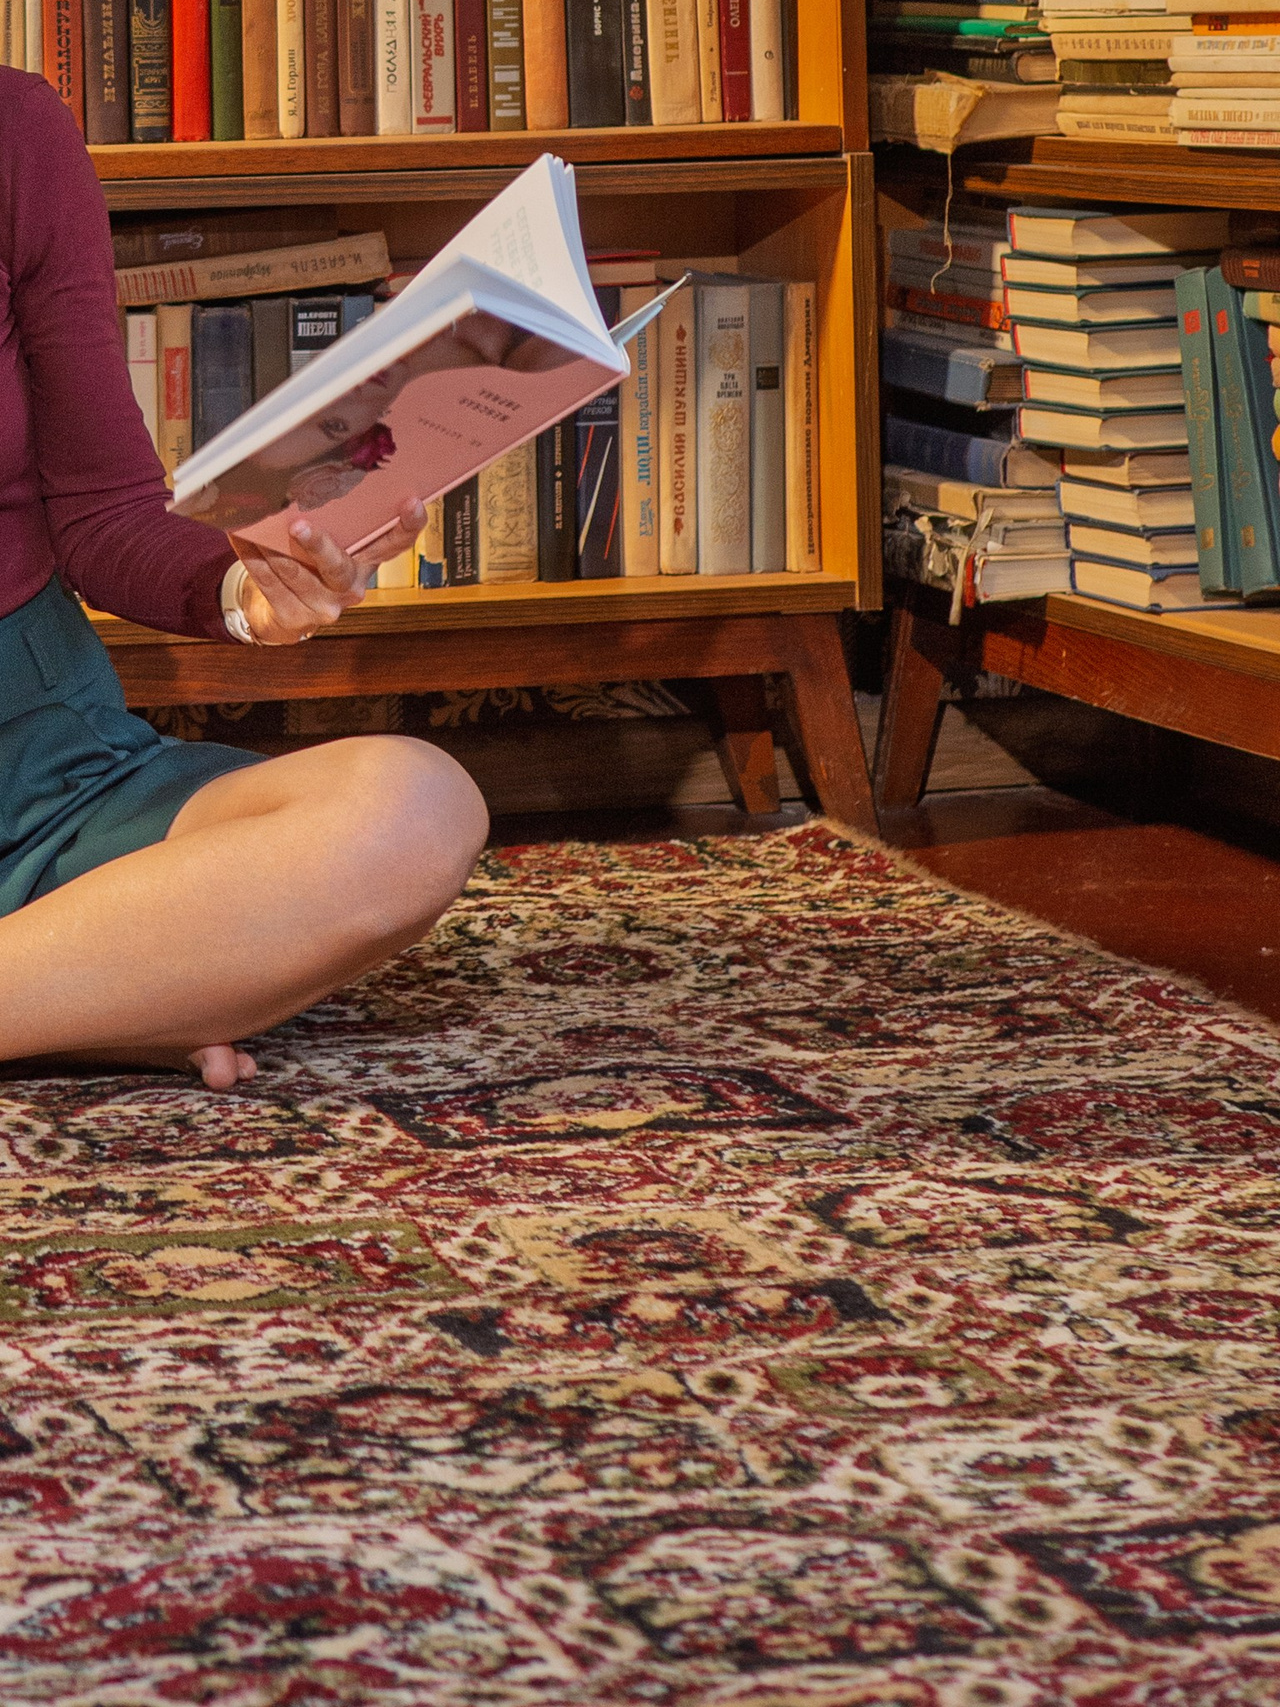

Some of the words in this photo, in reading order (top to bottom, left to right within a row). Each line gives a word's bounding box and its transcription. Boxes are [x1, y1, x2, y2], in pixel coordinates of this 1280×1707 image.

[55, 0, 72, 99] СОЛЛОГУБ
[434, 13, 446, 58] ВИХРЬ
[593, 5, 603, 36] БОРИС
[420, 13, 434, 114] ФЕВРАЛЬСКИЙ
[674, 345, 687, 426] ШУКШИН
[673, 432, 687, 515] ВАСИЛИЙ
